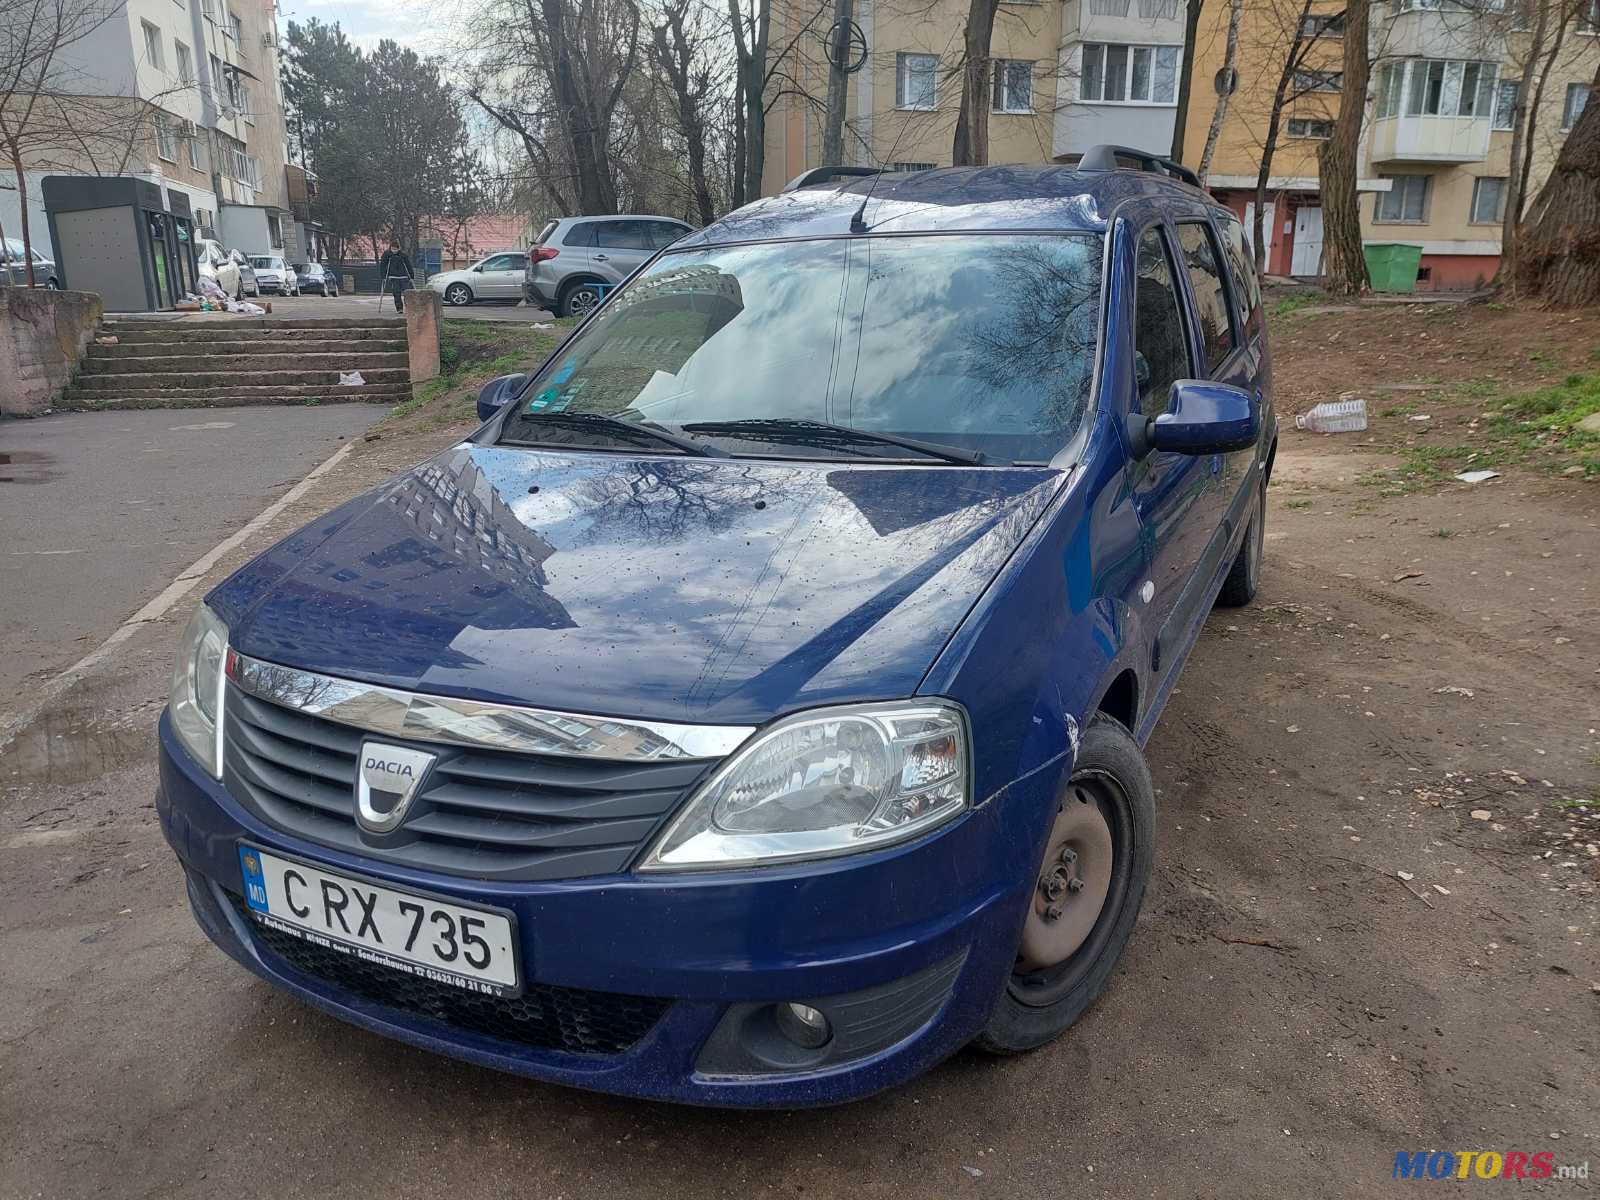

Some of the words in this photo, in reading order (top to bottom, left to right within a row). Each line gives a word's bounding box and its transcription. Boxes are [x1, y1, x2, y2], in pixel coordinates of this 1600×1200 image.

[365, 758, 413, 777] DACIA
[248, 882, 266, 904] MD
[283, 869, 310, 918] C
[320, 878, 383, 944] RX
[399, 900, 491, 970] 735
[264, 917, 302, 938] Autohaus
[358, 949, 413, 974] Sondershausen
[467, 980, 478, 992] 21
[480, 983, 492, 995] 06
